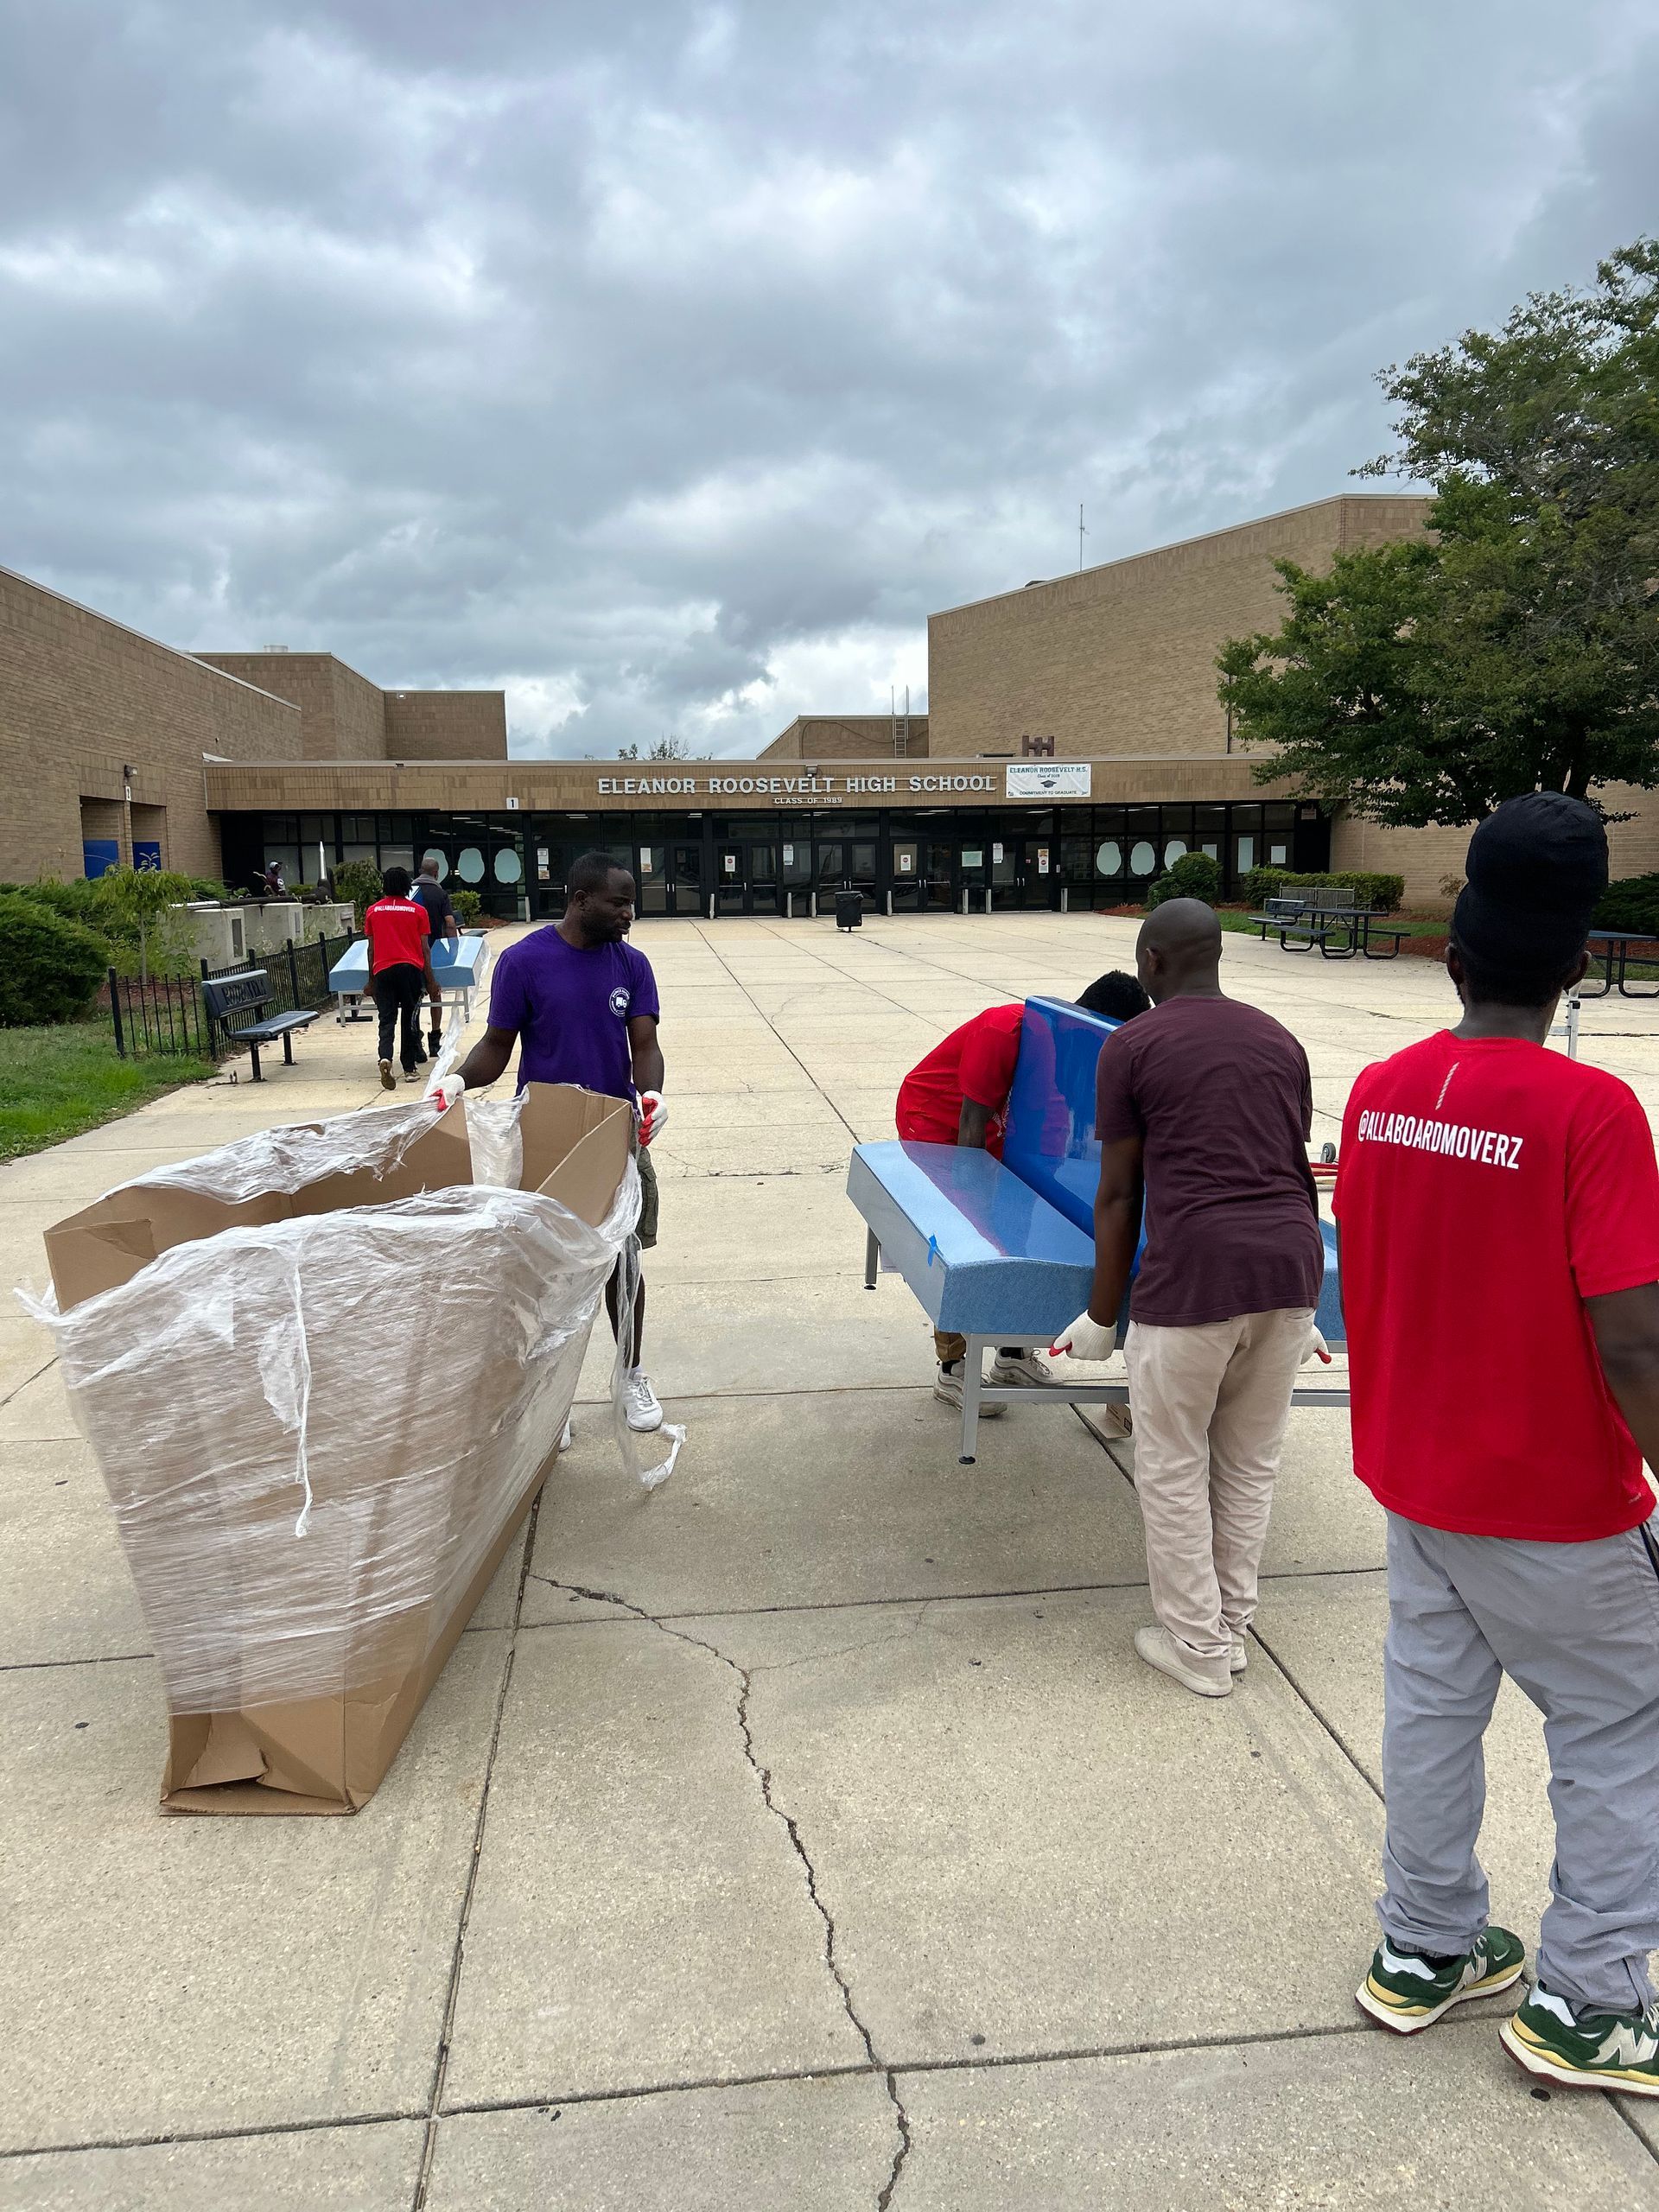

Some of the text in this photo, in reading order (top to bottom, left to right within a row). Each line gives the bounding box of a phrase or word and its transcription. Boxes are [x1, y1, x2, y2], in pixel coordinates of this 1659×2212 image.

[598, 775, 996, 794] ELEANOR ROOSEVELT HIGH SCHOOL
[1357, 1109, 1523, 1169] @ALLABOARDMOVERZ
